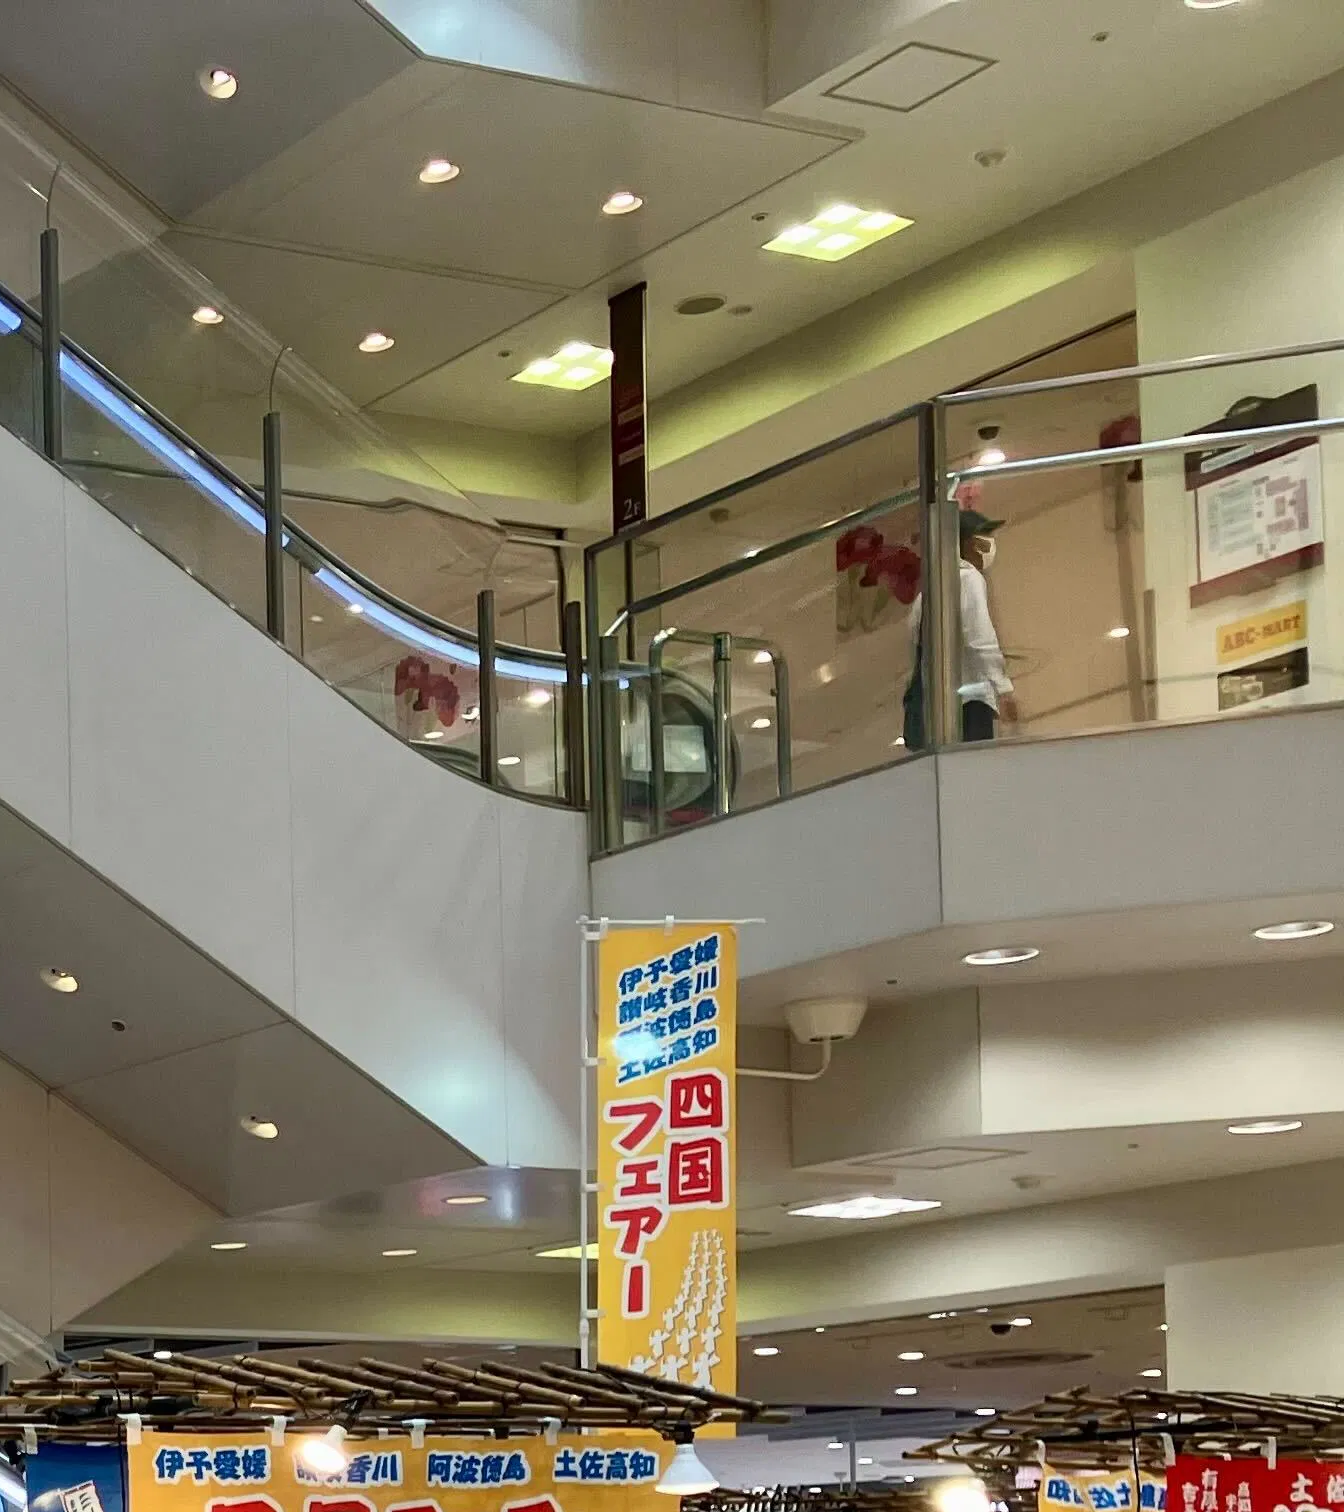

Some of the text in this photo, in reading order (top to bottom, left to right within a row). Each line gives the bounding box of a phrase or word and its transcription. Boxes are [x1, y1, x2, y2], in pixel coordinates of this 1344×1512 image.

[623, 498, 642, 521] 2F
[1222, 615, 1301, 653] ABC-MART
[618, 935, 720, 996] 伊予愛媛
[618, 997, 718, 1055] 波徳島
[669, 1073, 724, 1205] 四国
[610, 1101, 663, 1313] フェアー
[155, 1449, 269, 1480] 伊予愛媛
[428, 1453, 528, 1484] 阿波徳島
[555, 1450, 656, 1481] 土佐高知
